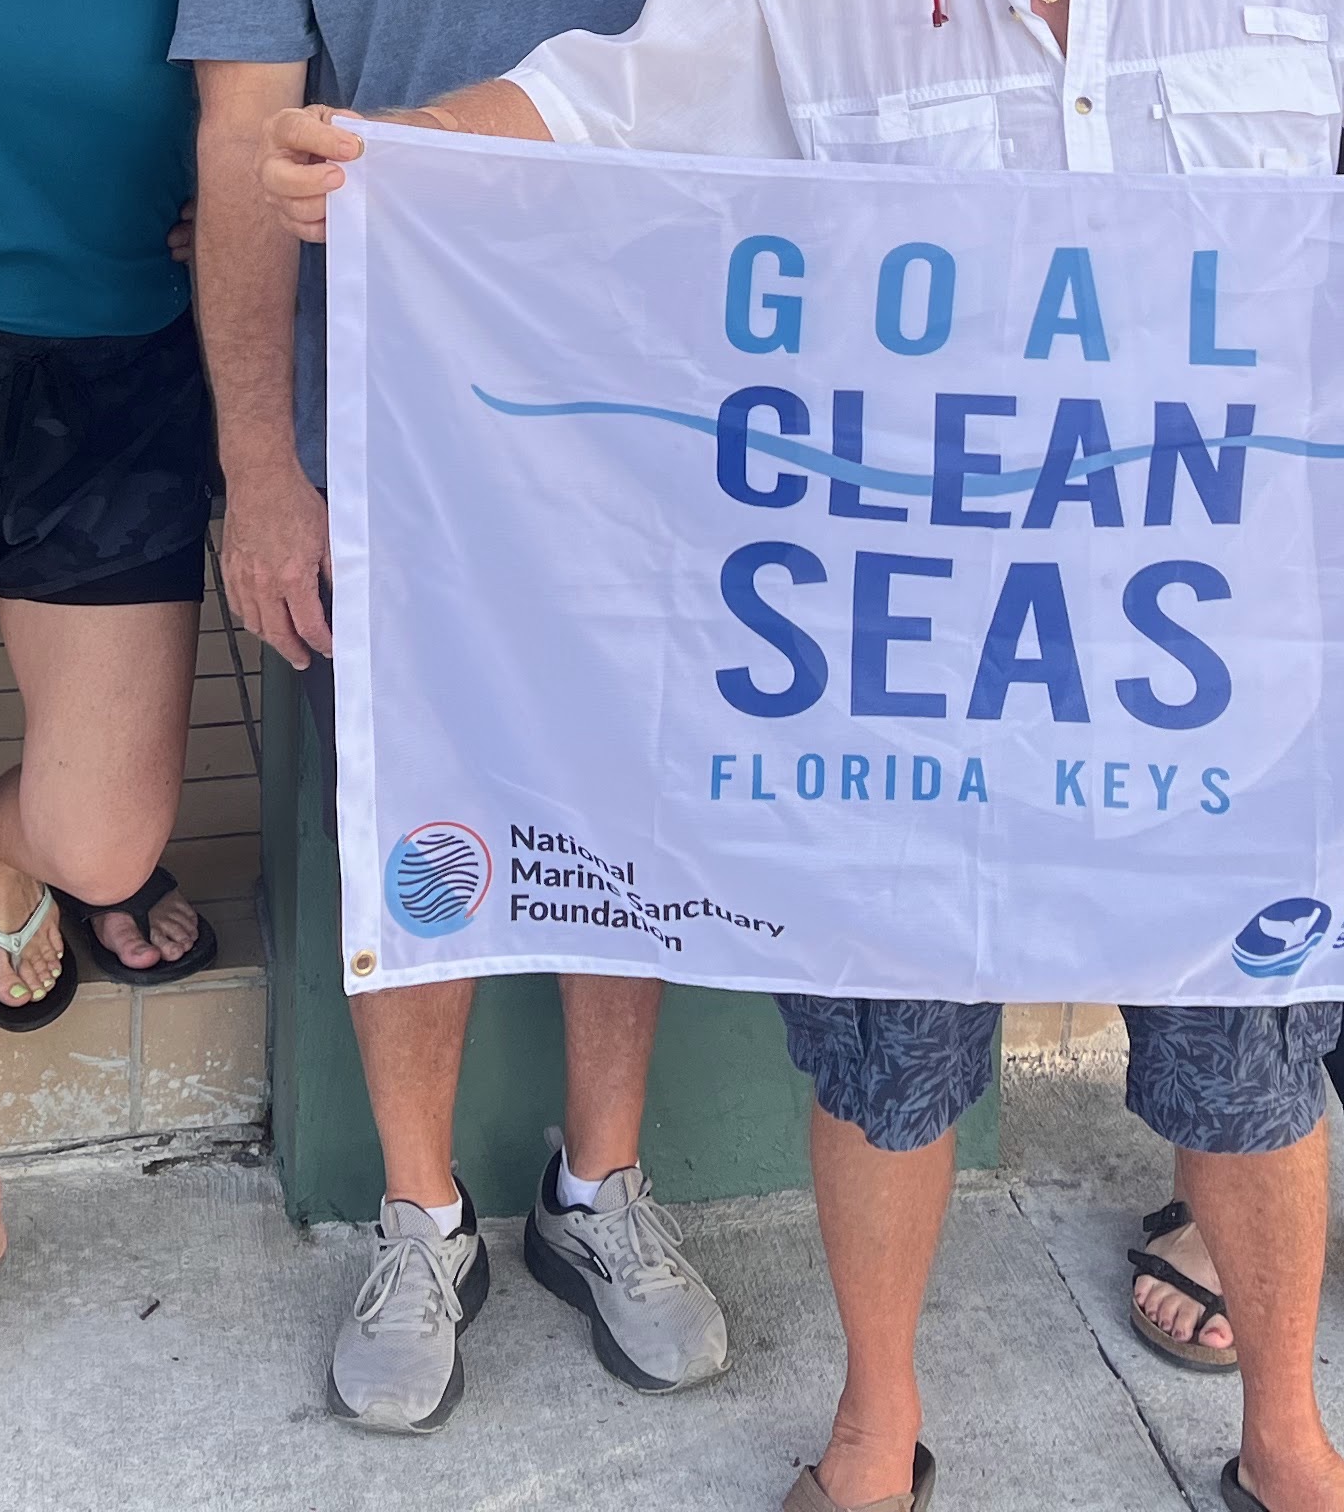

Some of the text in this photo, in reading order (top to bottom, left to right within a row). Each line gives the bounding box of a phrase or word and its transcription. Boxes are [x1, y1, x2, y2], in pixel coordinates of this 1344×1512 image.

[724, 235, 1257, 366] GOAL
[716, 385, 1256, 529] CLEAN
[715, 540, 1233, 731] SEAS
[711, 753, 1231, 816] FLORIDA KEYS
[510, 824, 635, 886] National
[509, 894, 683, 953] Foundation
[510, 858, 786, 938] Marine Sanctuary
